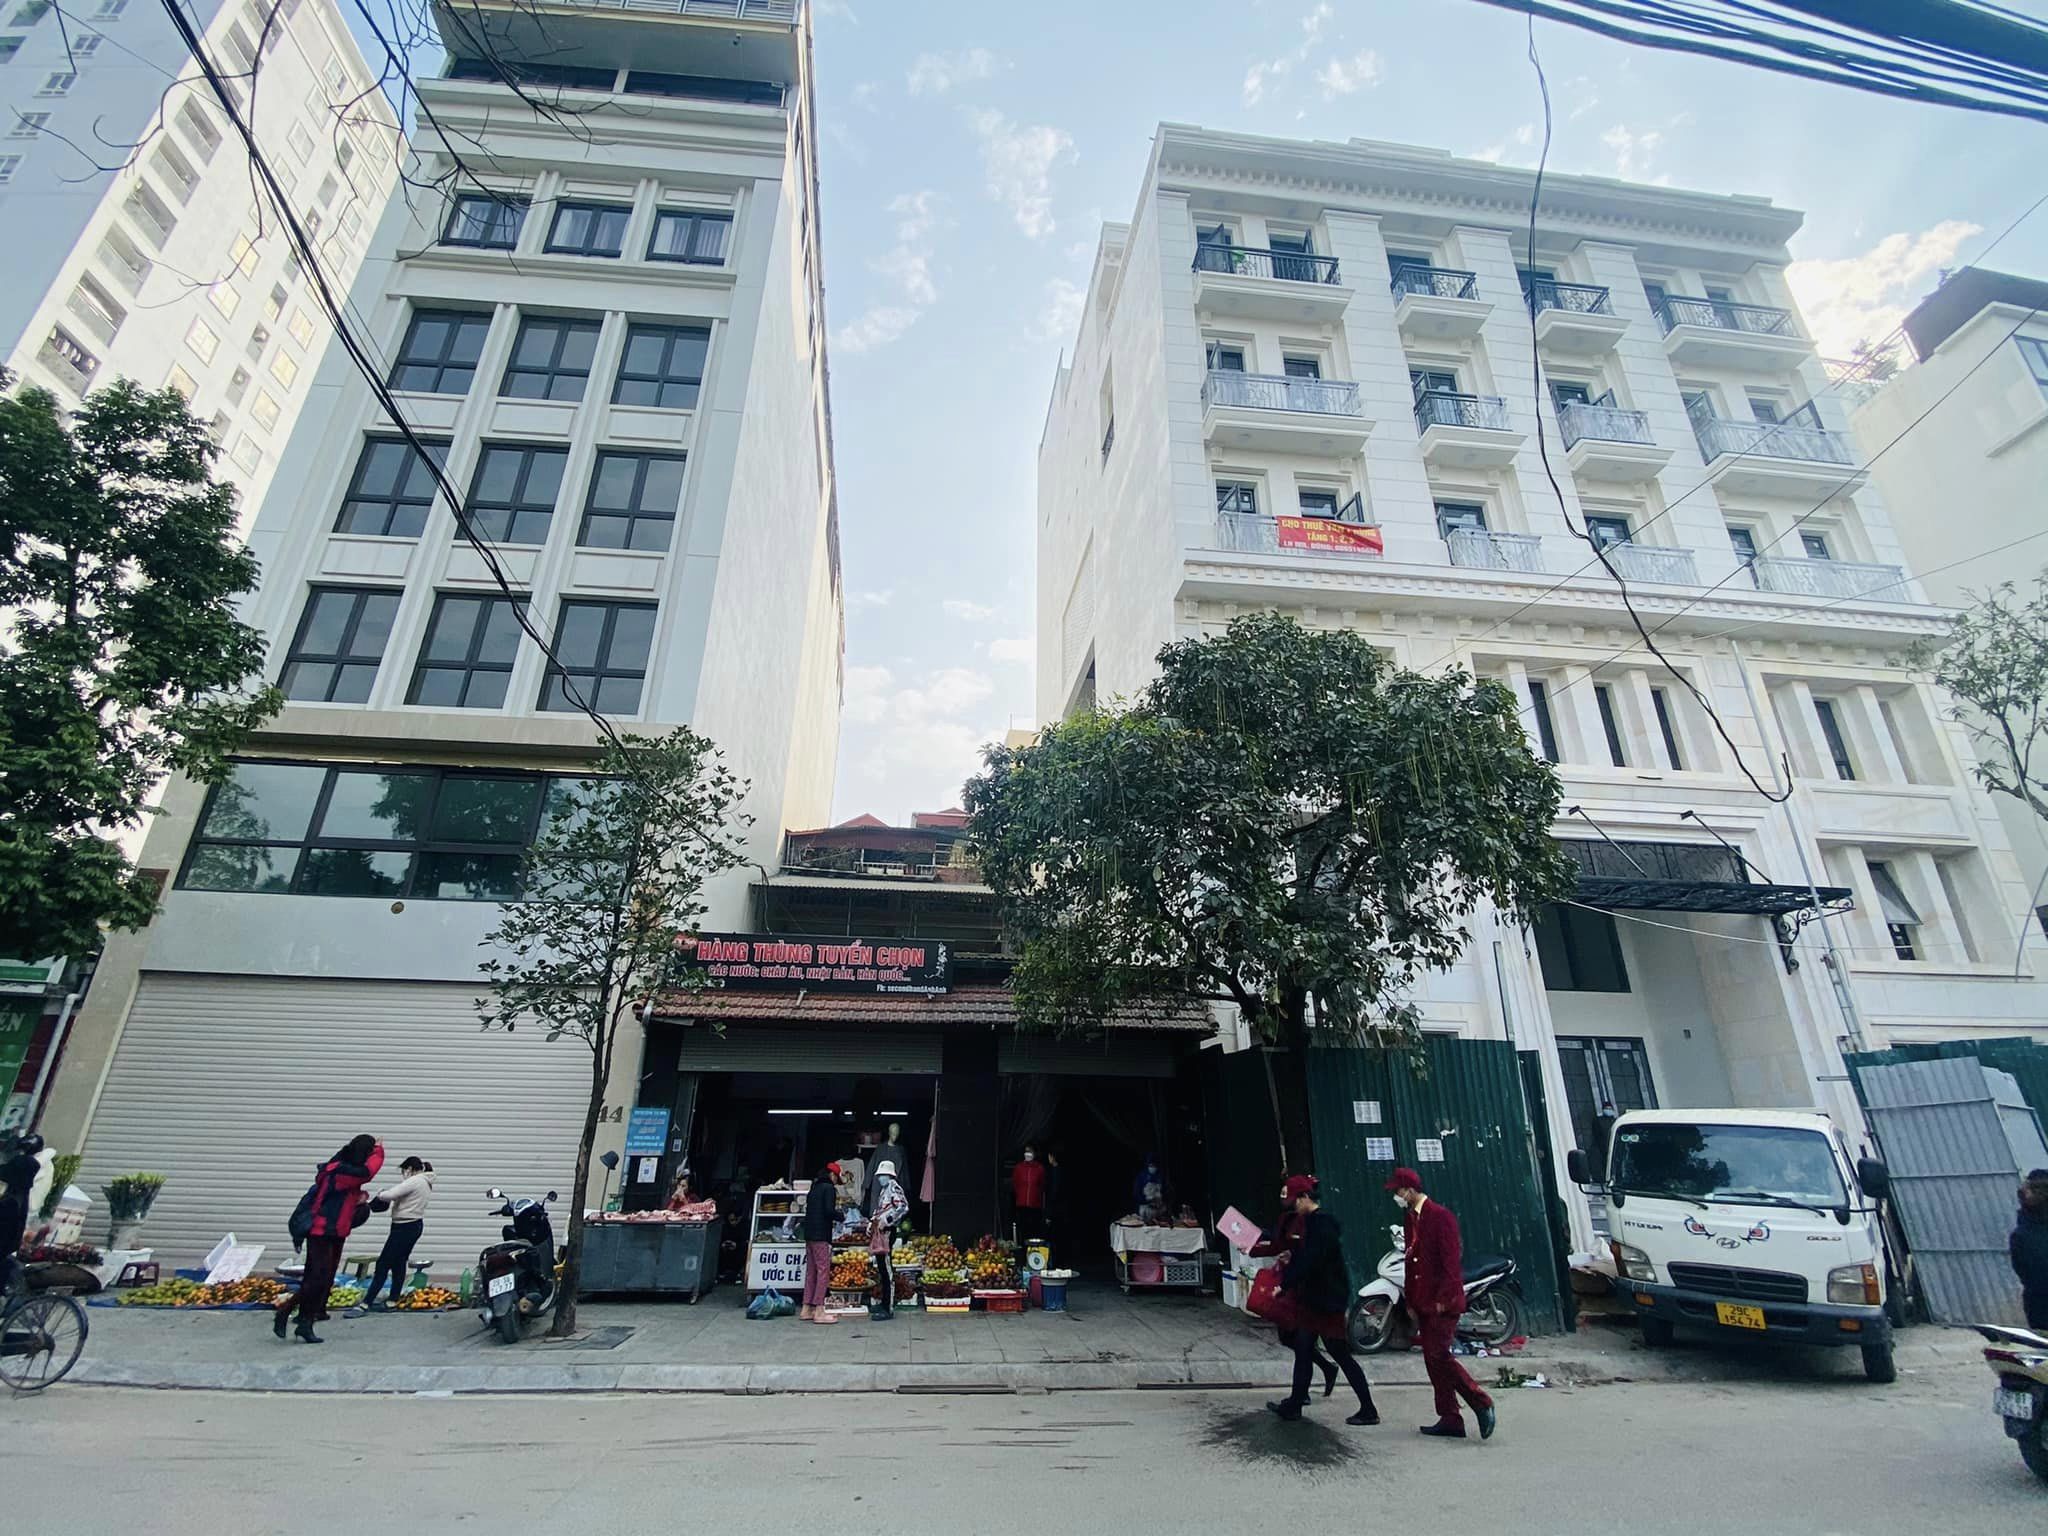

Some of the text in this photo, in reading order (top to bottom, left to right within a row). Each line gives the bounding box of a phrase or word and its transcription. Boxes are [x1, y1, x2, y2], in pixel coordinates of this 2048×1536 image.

[697, 938, 749, 961] HÀNG
[753, 939, 813, 964] THÙNG
[876, 946, 925, 971] CHỌN
[708, 963, 729, 976] CÁC
[761, 965, 788, 978] CHÂU
[806, 966, 832, 981] NHẬT
[857, 967, 877, 980] HÀN
[760, 1249, 779, 1264] GIÒ
[762, 1265, 785, 1281] ƯỚC
[1729, 1305, 1751, 1317] 29C
